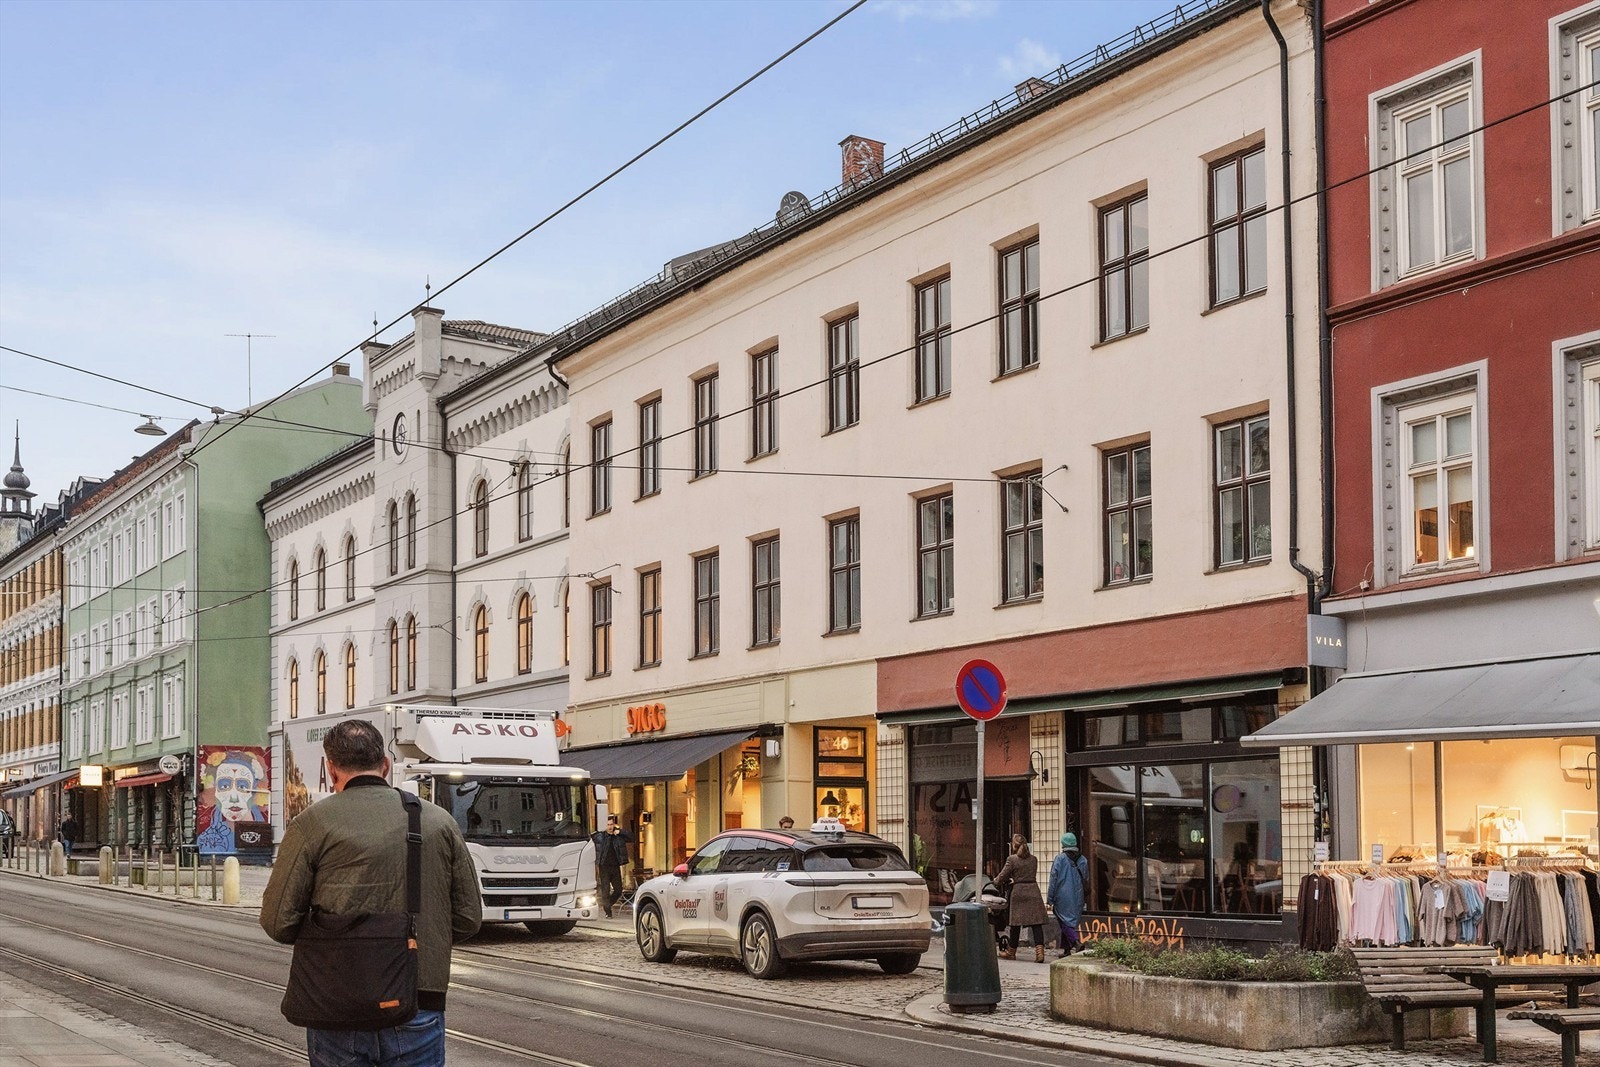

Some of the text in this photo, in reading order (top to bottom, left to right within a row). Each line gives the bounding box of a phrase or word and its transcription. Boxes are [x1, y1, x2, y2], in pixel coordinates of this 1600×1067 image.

[1316, 636, 1342, 647] VILA
[452, 723, 538, 738] ASKO
[493, 855, 548, 865] SCANIA
